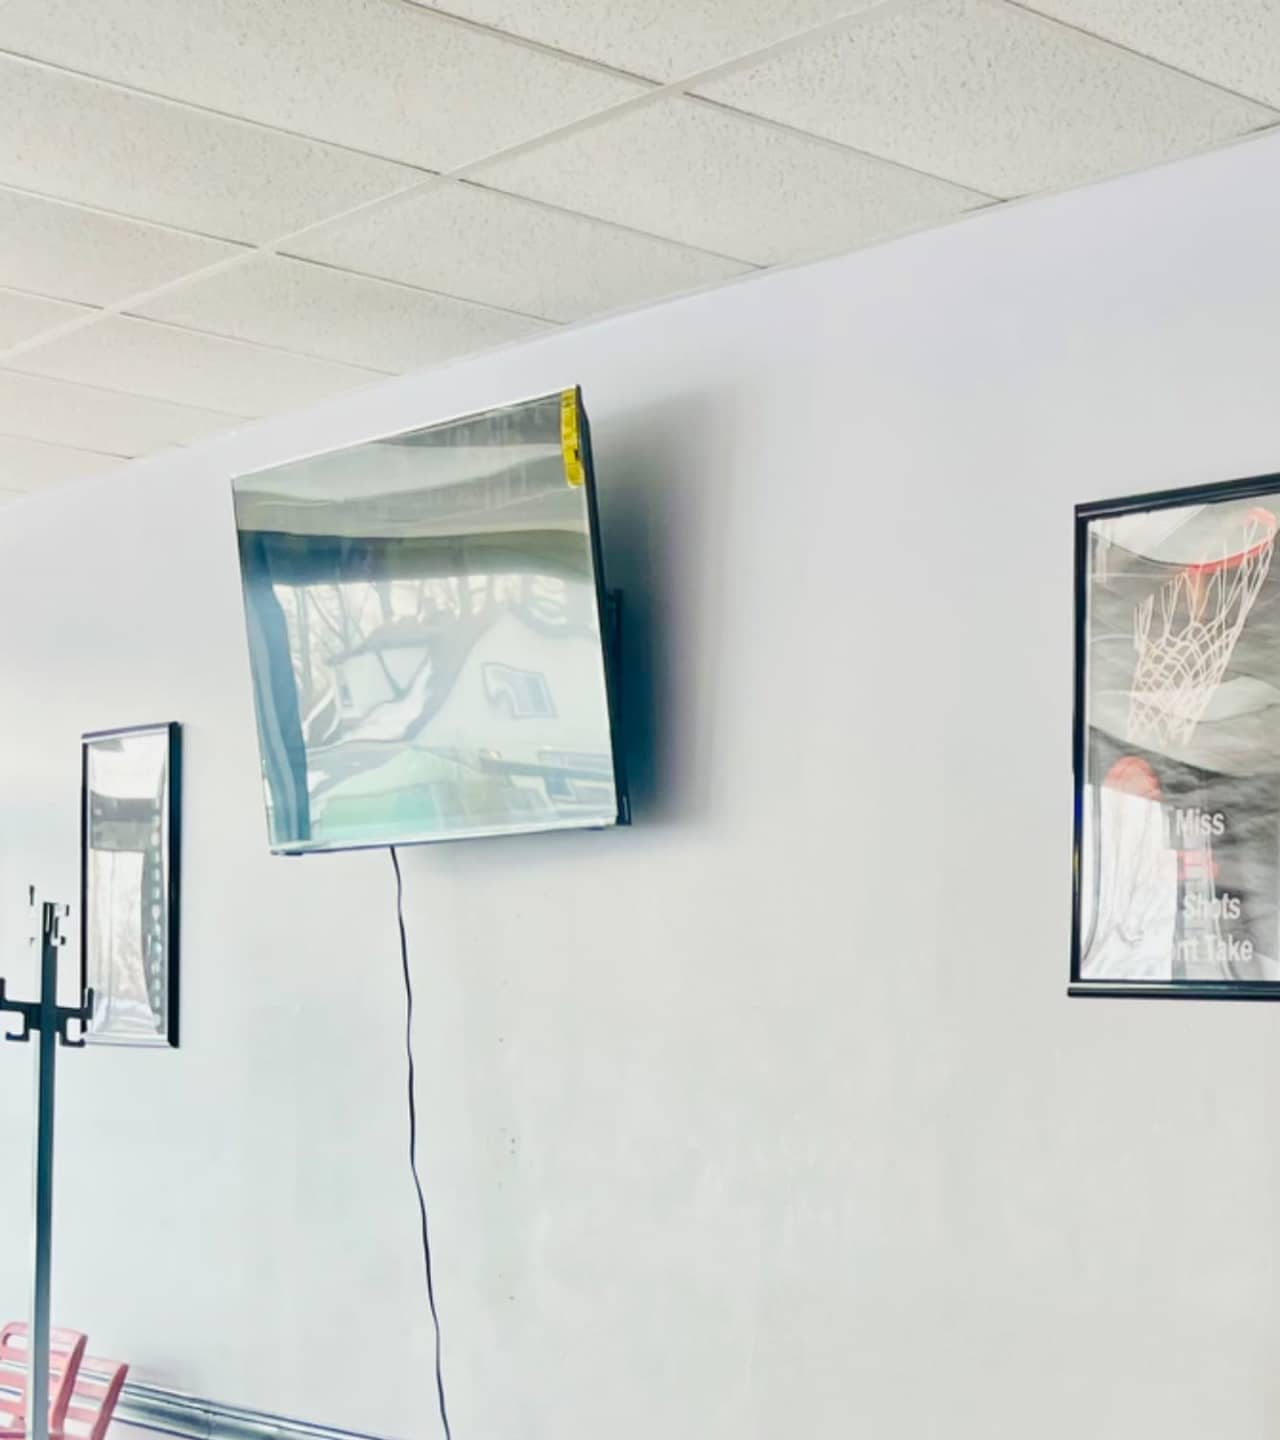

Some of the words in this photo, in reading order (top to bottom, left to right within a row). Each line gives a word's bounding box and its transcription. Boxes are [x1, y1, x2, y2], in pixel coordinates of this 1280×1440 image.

[1176, 808, 1224, 836] Miss
[1183, 893, 1241, 919] Shots
[1203, 932, 1253, 962] Take
